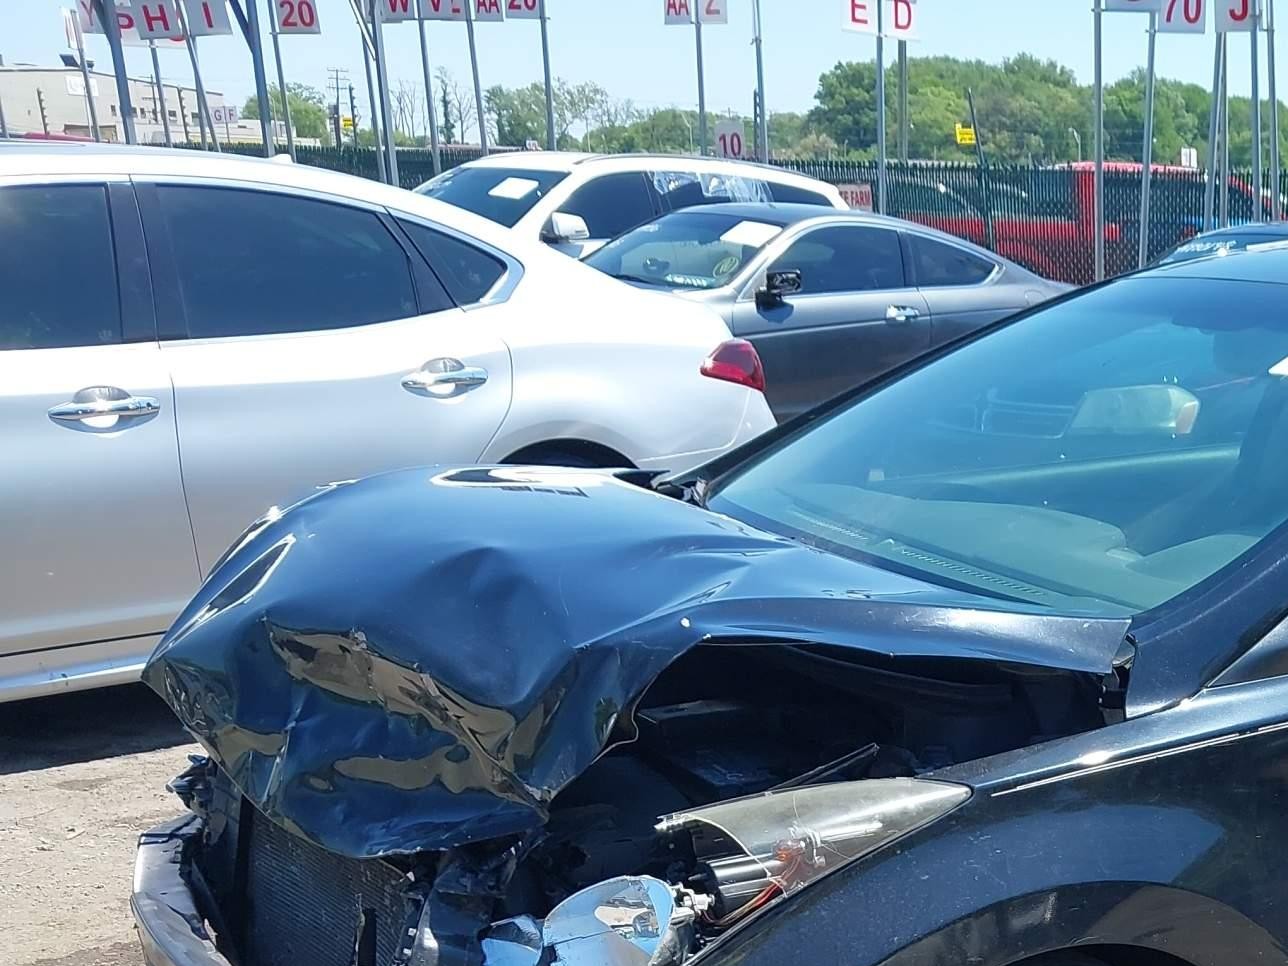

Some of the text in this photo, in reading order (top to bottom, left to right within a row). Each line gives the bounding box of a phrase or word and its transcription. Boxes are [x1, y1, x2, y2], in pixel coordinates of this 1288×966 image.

[142, 4, 170, 32] H
[202, 2, 213, 29] I
[280, 0, 315, 28] 20
[851, 0, 868, 24] E
[895, 0, 912, 30] D
[718, 132, 742, 159] 10
[851, 190, 871, 207] FARM
